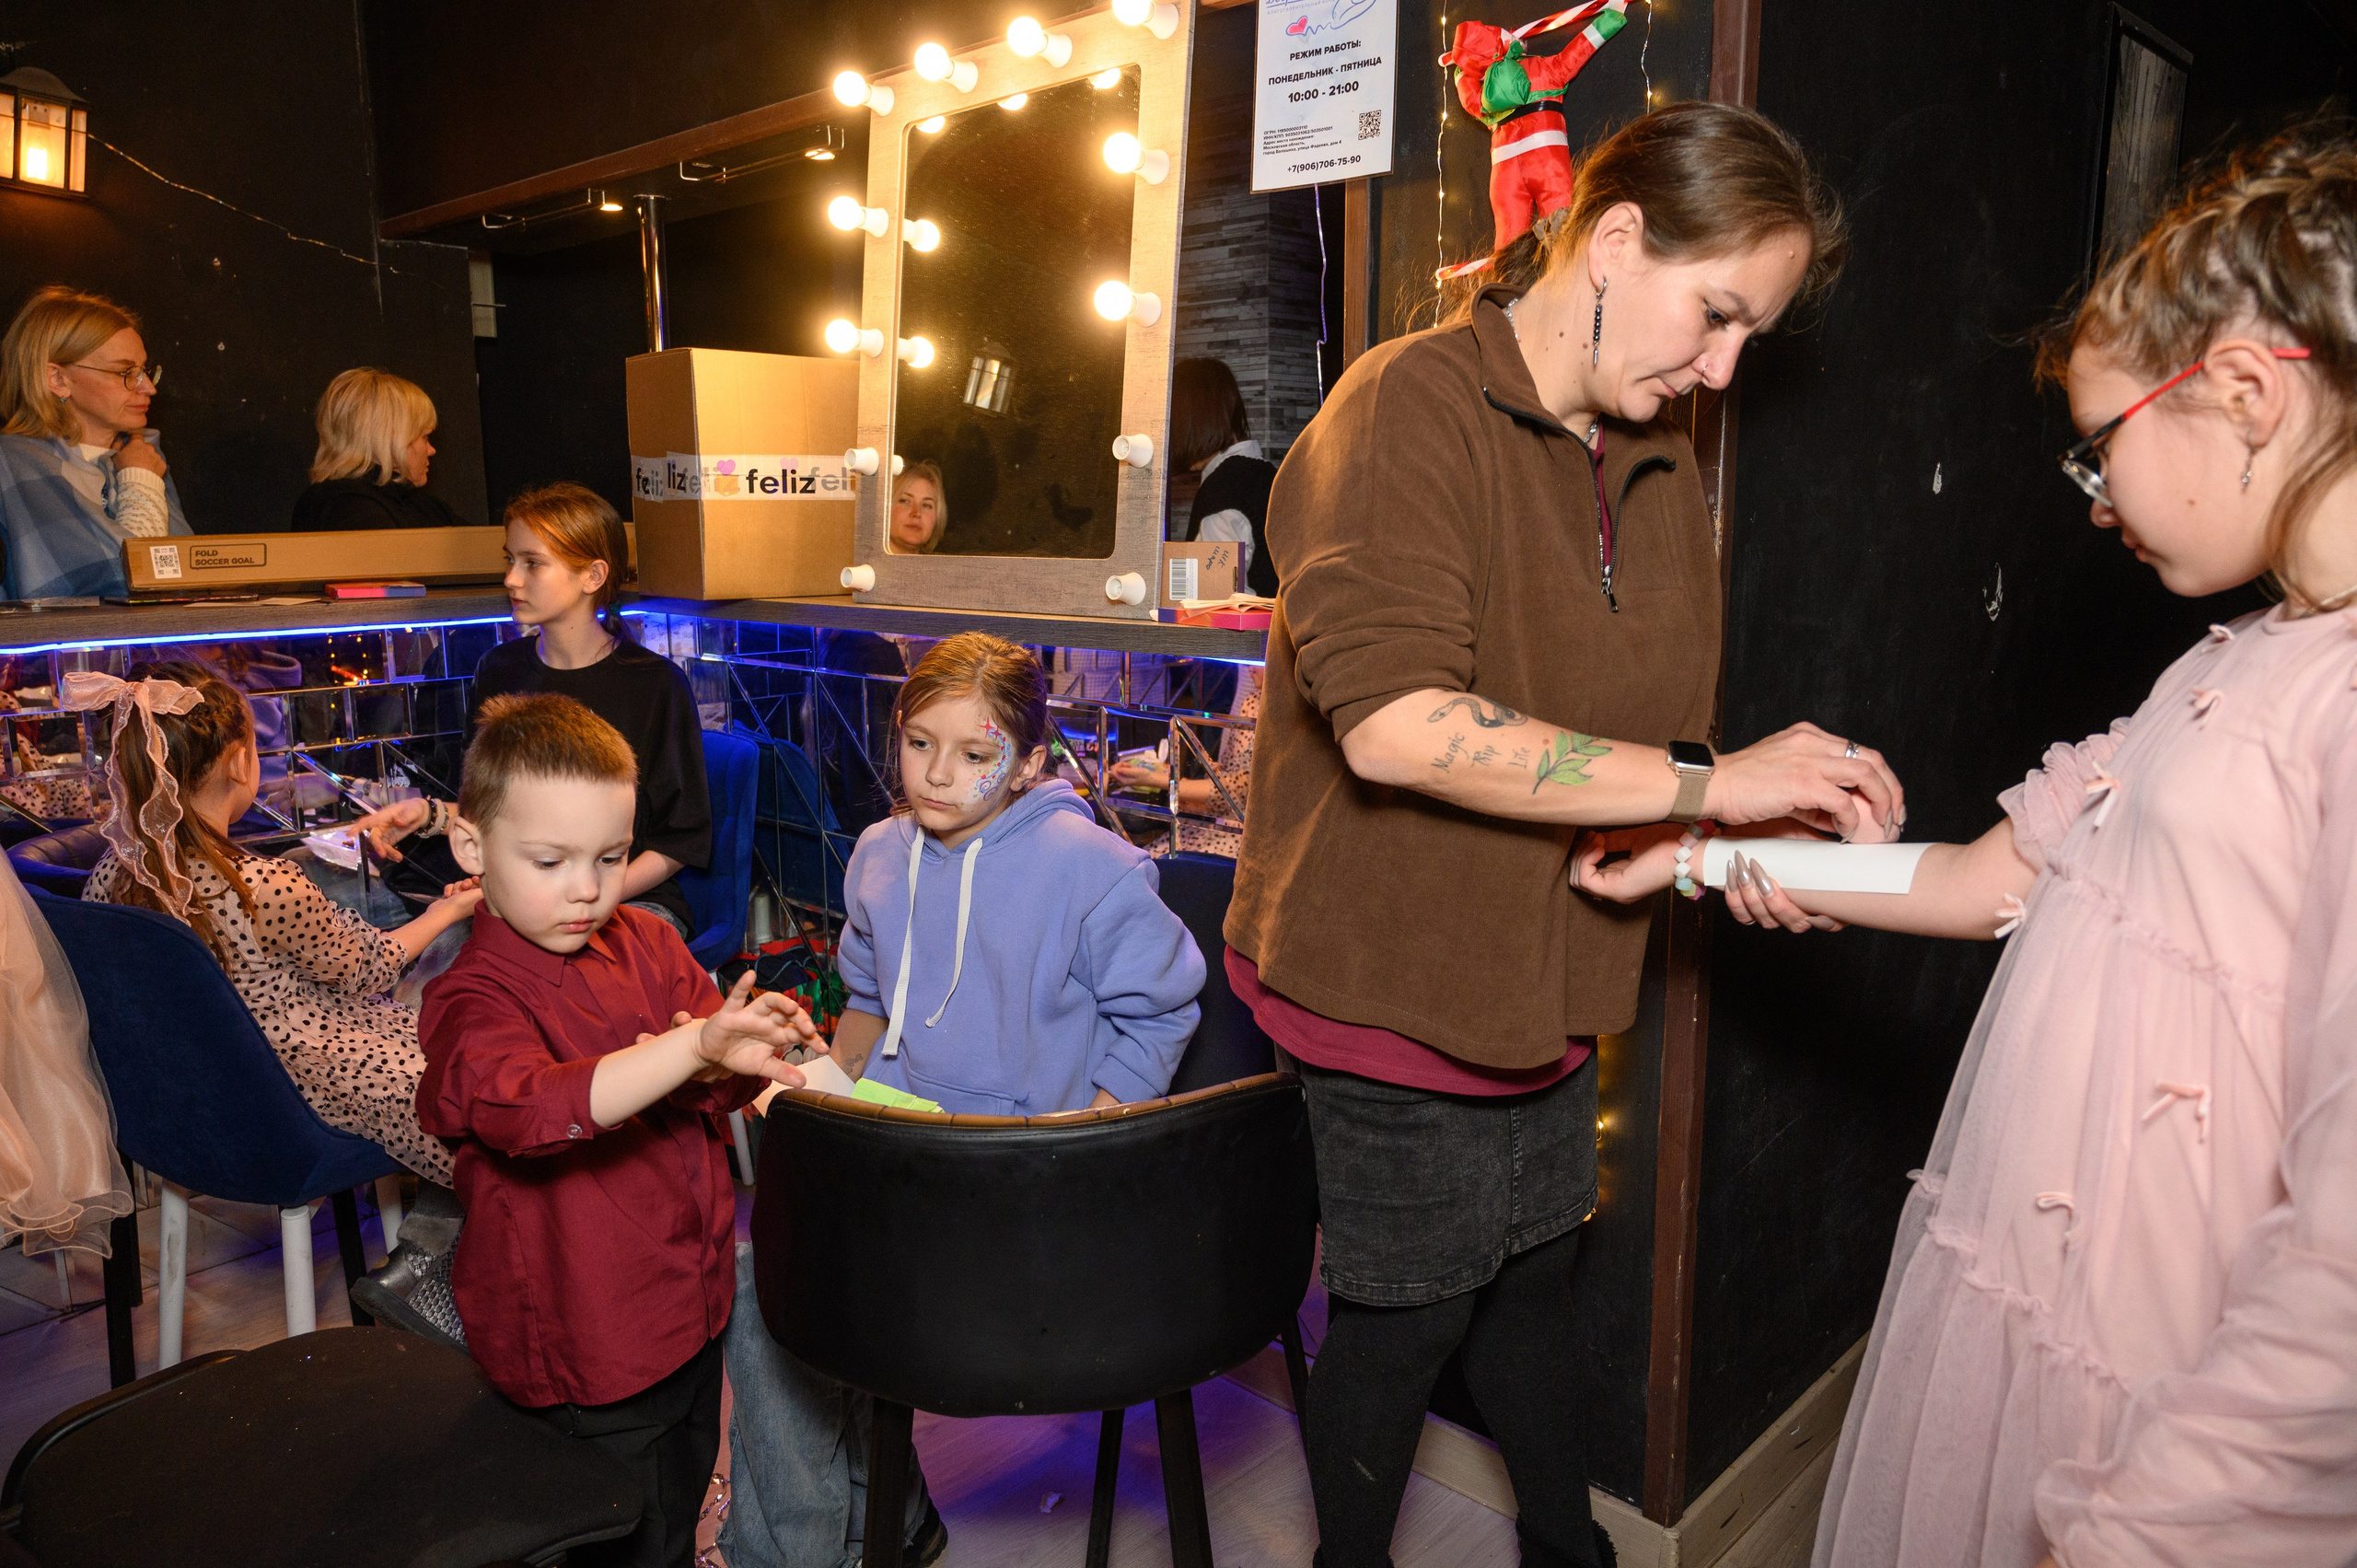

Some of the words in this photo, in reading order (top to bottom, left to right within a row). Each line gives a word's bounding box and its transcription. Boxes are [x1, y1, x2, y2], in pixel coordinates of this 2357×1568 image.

[1289, 48, 1322, 61] РЕЖИМ
[1324, 40, 1362, 54] РАБОТЫ:
[1268, 67, 1334, 86] ПОНЕДЕЛЬНИК
[1340, 56, 1382, 73] ПЯТНИЦА
[1288, 88, 1318, 103] 10:00
[1329, 81, 1359, 97] 21:00
[1287, 155, 1362, 173] +7(906)706-75-90
[746, 469, 817, 494] feliz
[195, 558, 229, 566] SOCCER
[1431, 732, 1469, 773] Magic
